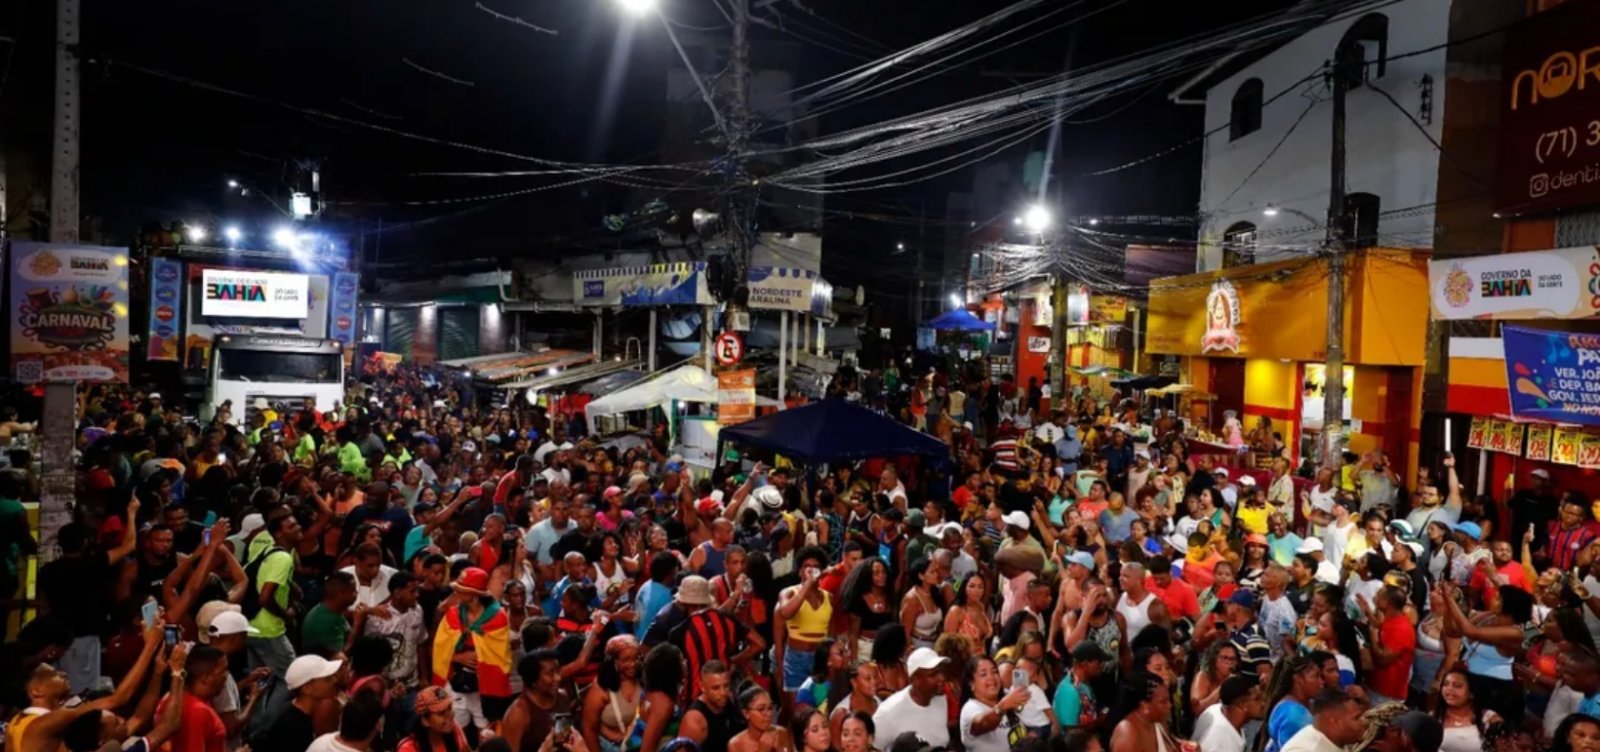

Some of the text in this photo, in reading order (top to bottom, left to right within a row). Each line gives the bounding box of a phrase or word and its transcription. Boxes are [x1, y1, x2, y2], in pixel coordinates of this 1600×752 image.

[1535, 126, 1577, 163] (71)
[1551, 162, 1600, 189] denti
[1520, 268, 1532, 278] DA
[206, 283, 266, 302] BAHIA
[752, 287, 803, 298] NORDESTE
[1481, 279, 1532, 298] BAHIA
[749, 295, 791, 305] ARALINA
[25, 313, 112, 331] CARNAVAL
[1577, 348, 1600, 366] PA
[1554, 367, 1580, 379] VER.
[1559, 379, 1585, 391] DEP.
